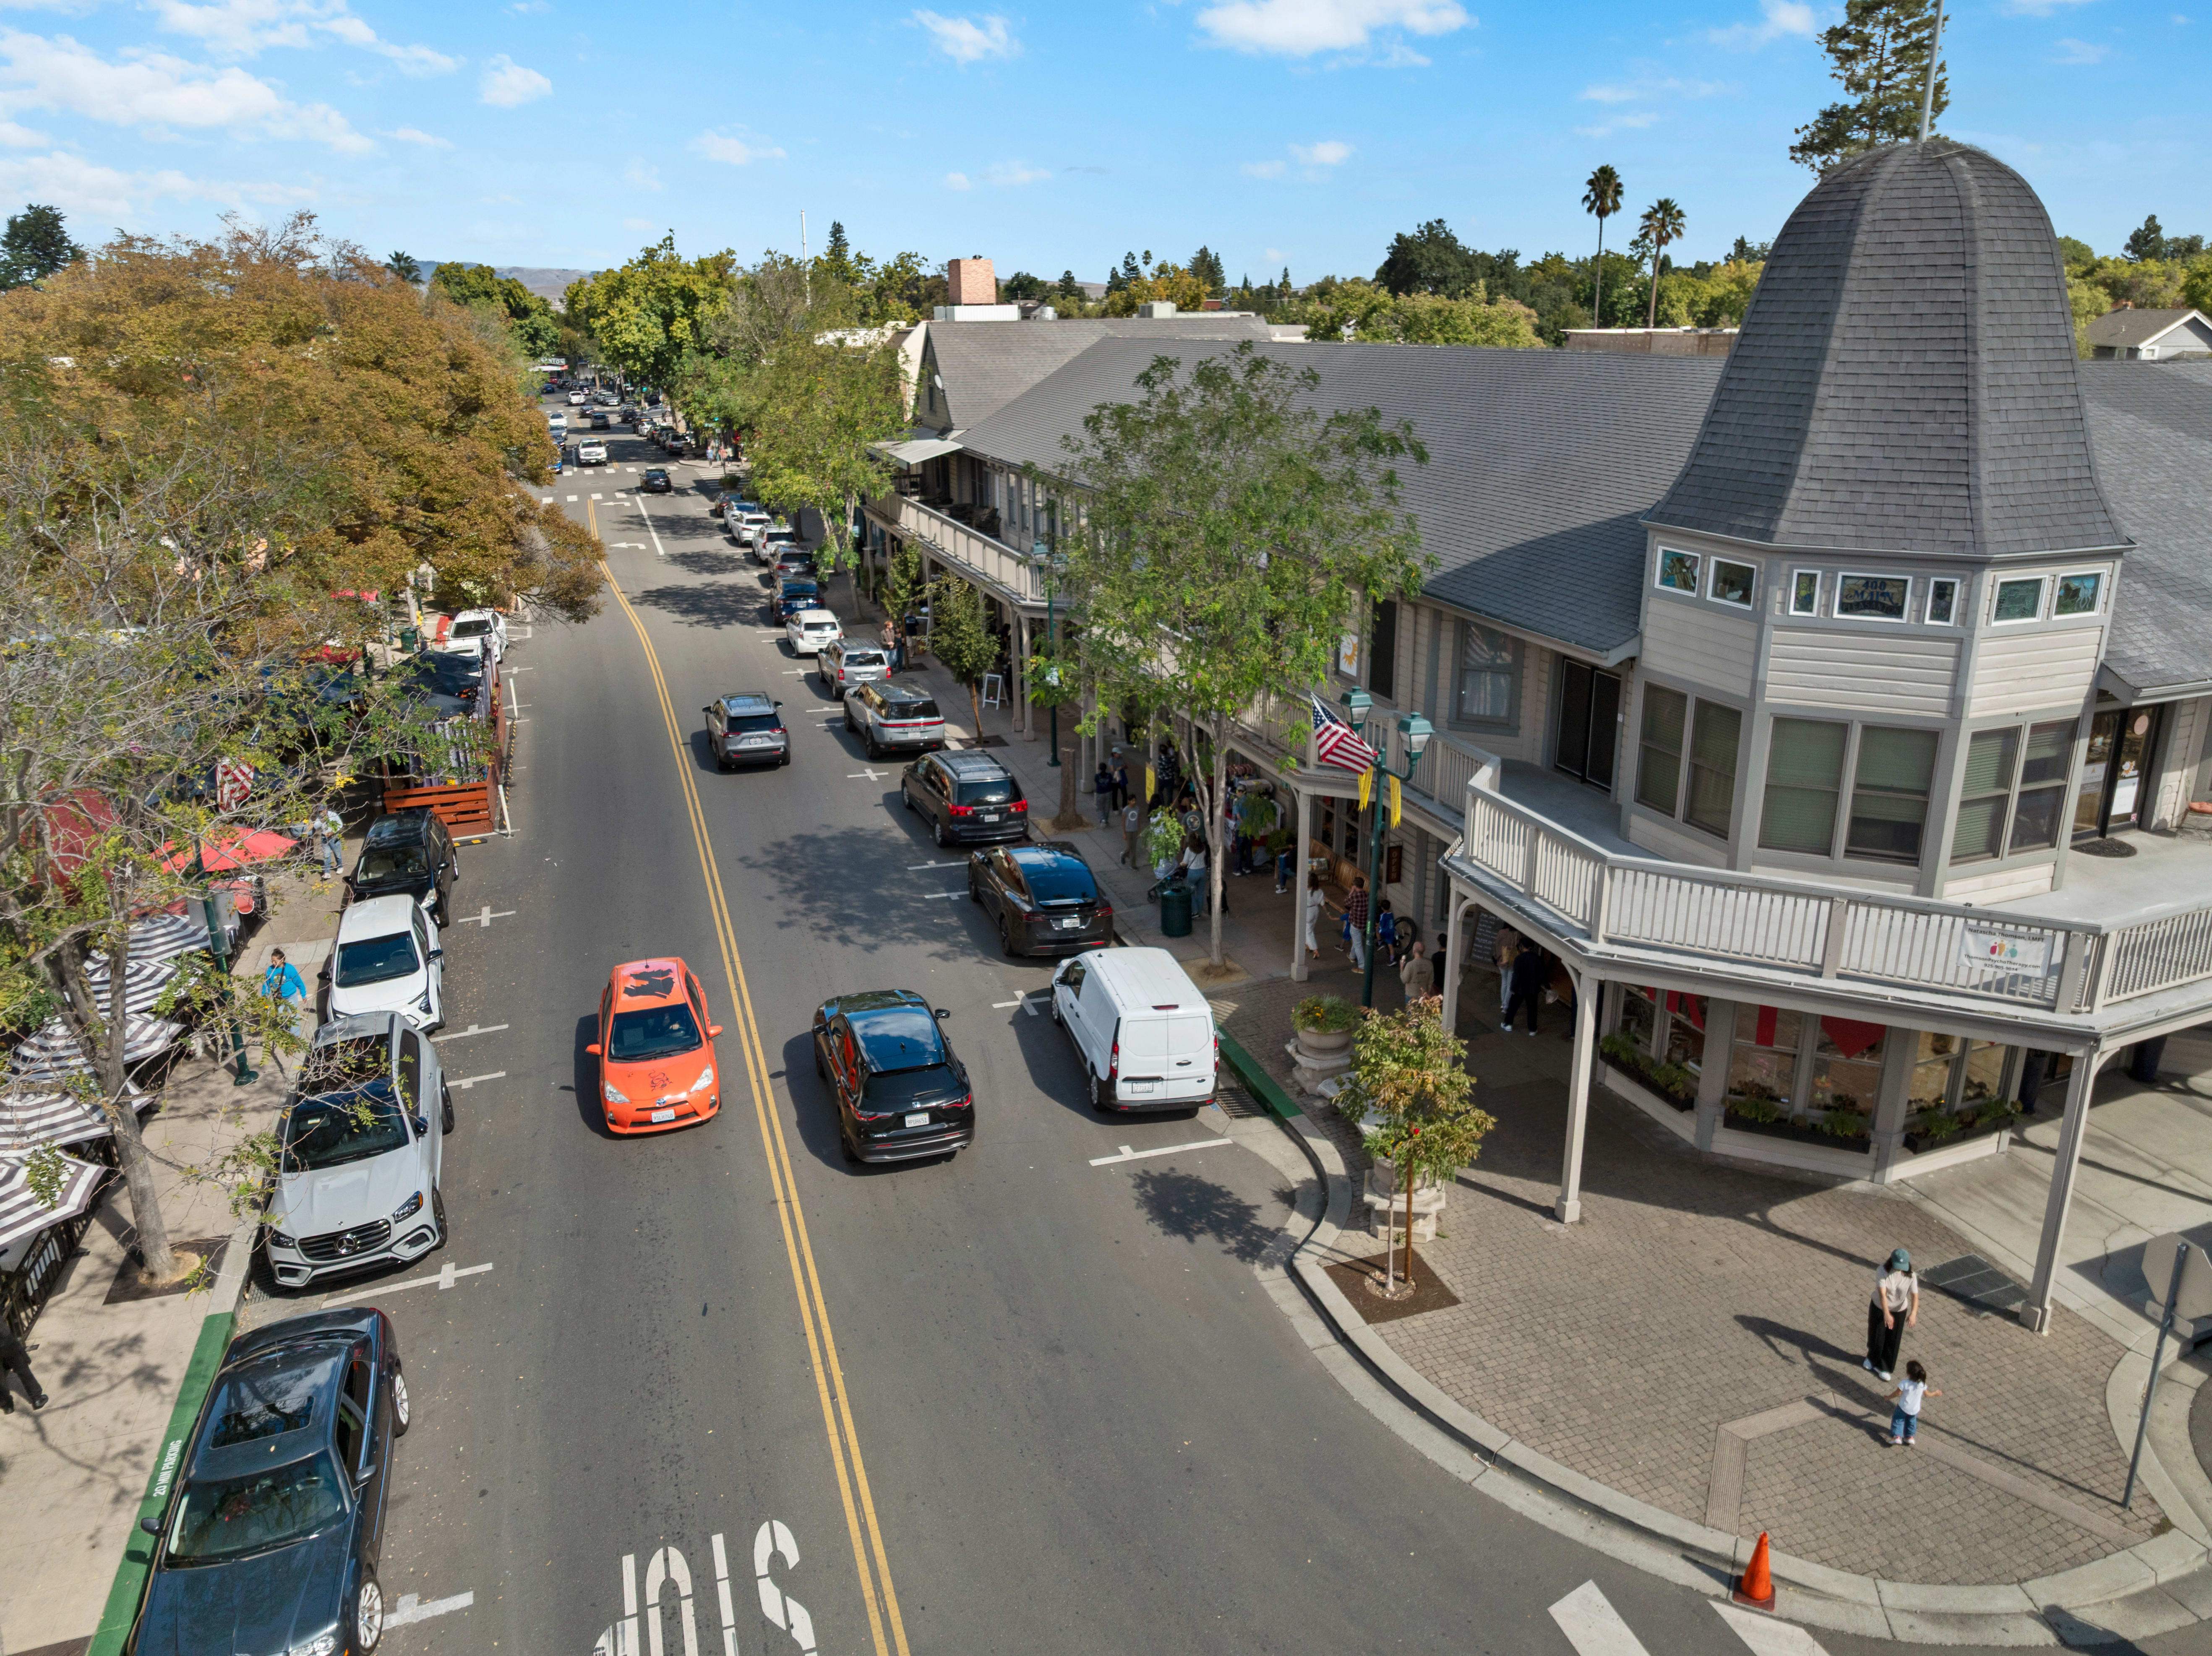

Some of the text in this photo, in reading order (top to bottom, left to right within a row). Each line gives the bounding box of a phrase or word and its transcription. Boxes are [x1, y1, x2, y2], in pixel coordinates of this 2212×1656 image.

[1862, 581, 1886, 591] 400
[1846, 590, 1894, 605] MAIN
[1968, 928, 1996, 936] Natascha
[1998, 932, 2027, 941] Thomson,
[1964, 954, 2040, 969] ThomsonPsychoTherapy.com
[1984, 963, 2018, 971] 925-905-9014
[153, 1440, 182, 1497] 20 MIN PARKING
